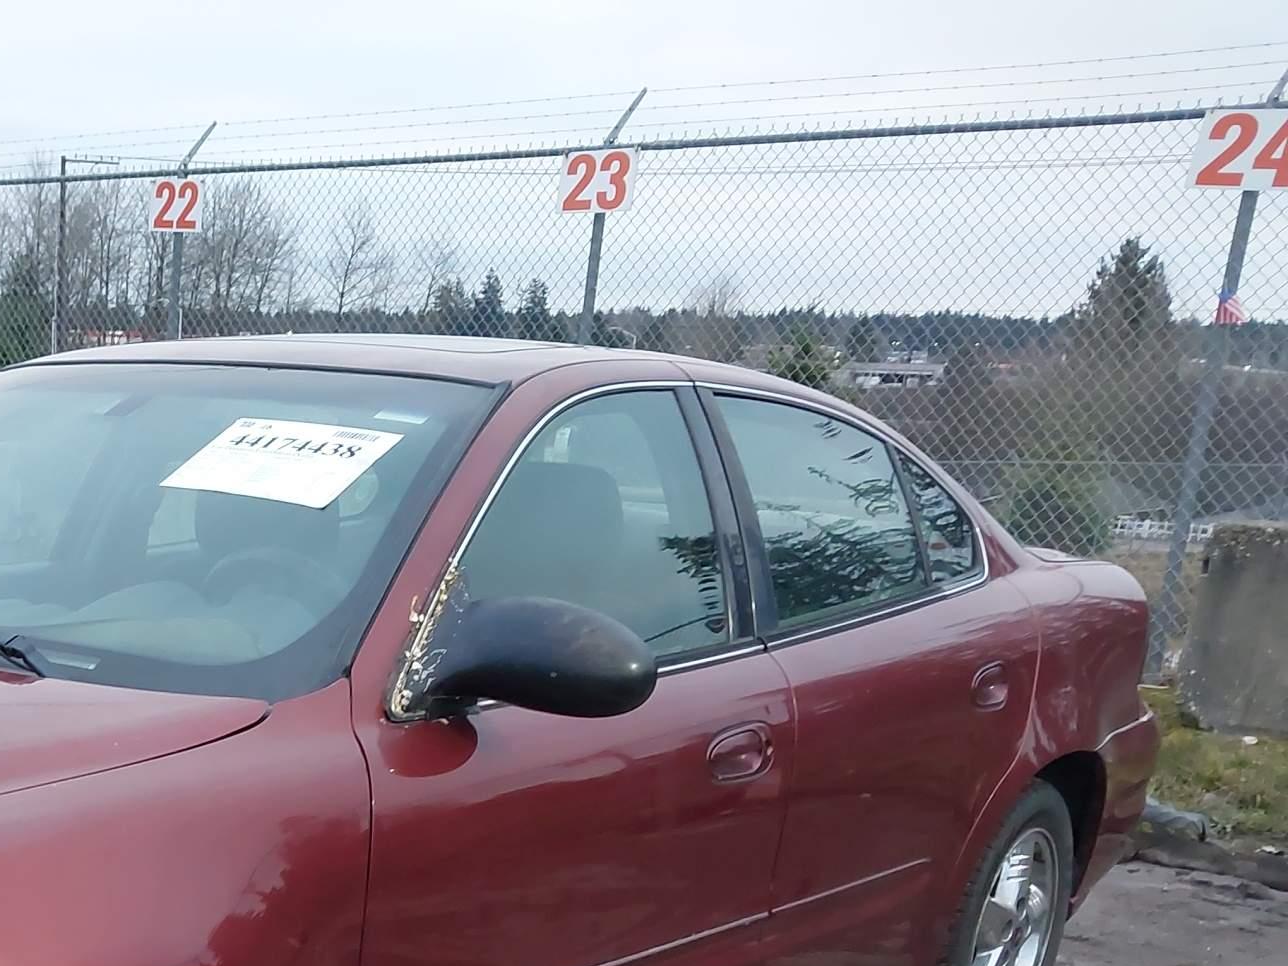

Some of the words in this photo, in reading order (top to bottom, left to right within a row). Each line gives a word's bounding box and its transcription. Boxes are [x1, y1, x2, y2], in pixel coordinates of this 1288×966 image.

[1194, 113, 1288, 187] 24
[153, 180, 199, 229] 22
[562, 151, 631, 211] 23
[229, 433, 362, 459] 44174438
